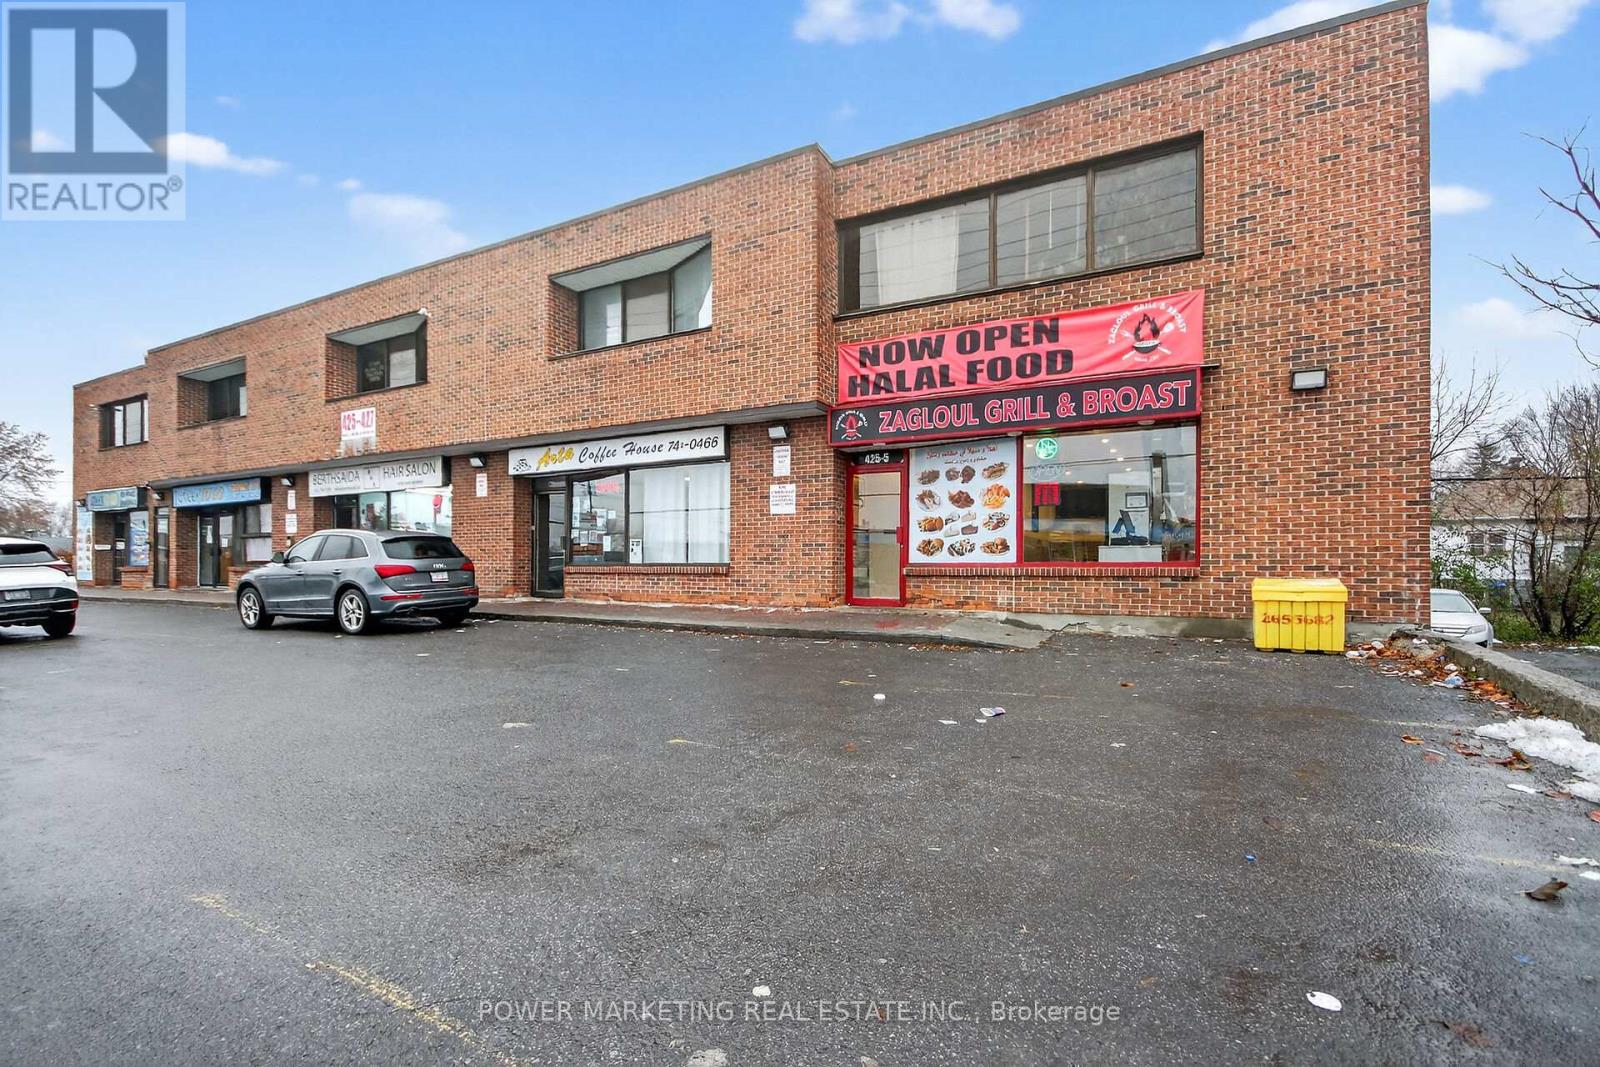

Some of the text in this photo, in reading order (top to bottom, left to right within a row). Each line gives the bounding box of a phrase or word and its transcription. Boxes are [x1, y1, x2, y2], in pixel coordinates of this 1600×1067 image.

[858, 317, 1060, 369] NOW OPEN
[847, 349, 1074, 397] HALAL FOOD
[878, 402, 981, 433] ZAGLOUL
[984, 395, 1050, 424] GRILL
[1056, 392, 1076, 417] &
[1082, 380, 1192, 415] BROAST
[343, 410, 374, 431] 425-427
[578, 446, 617, 464] Coffee
[622, 441, 664, 456] House
[864, 453, 890, 464] 425-5
[383, 465, 404, 479] HAIR
[405, 461, 436, 477] SALON
